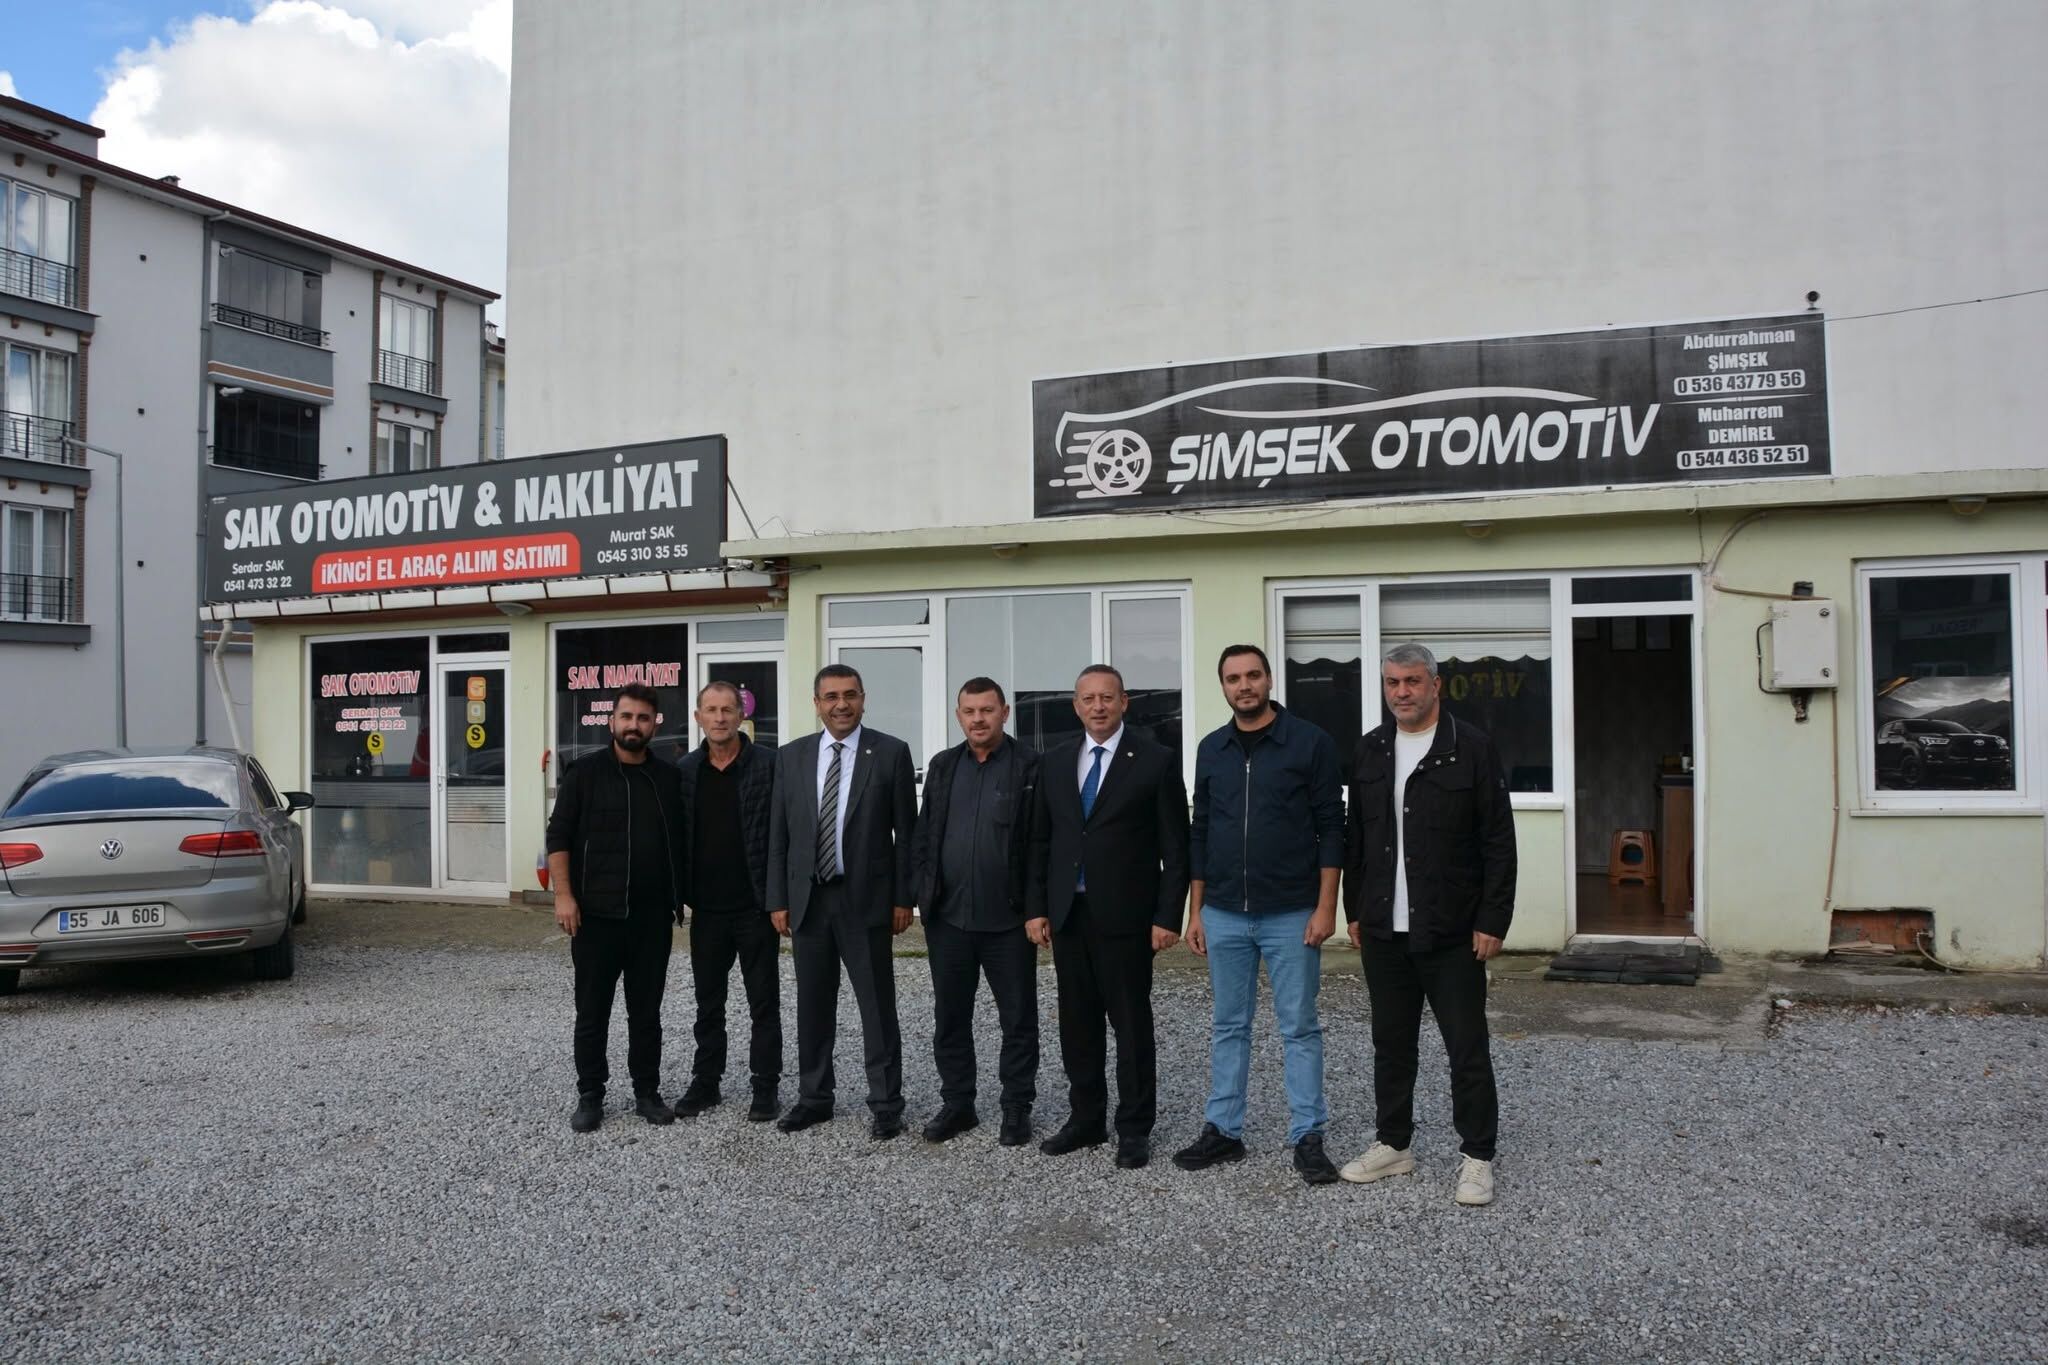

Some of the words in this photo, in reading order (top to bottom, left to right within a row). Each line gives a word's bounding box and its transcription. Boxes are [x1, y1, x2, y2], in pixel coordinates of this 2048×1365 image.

[1683, 330, 1795, 350] Abdurrahman
[1708, 351, 1768, 373] ŞİMŞEK
[1678, 379, 1687, 393] 0
[1692, 377, 1722, 392] 536
[1727, 375, 1754, 390] 437
[1758, 373, 1776, 388] 79
[1781, 371, 1801, 386] 56
[1698, 405, 1783, 423] Muharrem
[1708, 424, 1775, 444] DEMİREL
[1681, 453, 1690, 467] 0
[1696, 451, 1724, 466] 544
[1728, 449, 1758, 465] 436
[1763, 447, 1782, 463] 52
[1788, 446, 1805, 461] 51
[224, 505, 282, 550] SAK
[474, 481, 502, 527] &
[515, 453, 698, 523] NAKLİYAT
[610, 527, 646, 543] Murat
[650, 525, 675, 539] SAK
[377, 559, 395, 580] EL
[401, 554, 447, 579] ARAÇ
[452, 549, 497, 575] ALIM
[503, 544, 567, 571] SATIMI
[597, 548, 627, 564] 0545
[630, 547, 651, 562] 310
[655, 545, 670, 559] 35
[673, 544, 688, 558] 55
[232, 561, 263, 575] Serdar
[266, 560, 284, 572] SAK
[223, 579, 246, 592] 0541
[248, 578, 264, 590] 473
[266, 577, 278, 589] 32
[280, 576, 292, 588] 22
[321, 674, 348, 697] SAK
[568, 666, 600, 690] SAK
[342, 708, 379, 719] SERDAR
[380, 706, 402, 718] SAK
[581, 715, 608, 726] 0545
[336, 721, 358, 732] 0541
[359, 720, 378, 731] 473
[379, 720, 392, 730] 32
[393, 719, 406, 730] 22
[471, 727, 481, 741] S
[371, 734, 380, 748] S
[70, 912, 88, 928] 55
[101, 909, 120, 926] JA
[132, 908, 159, 924] 606
